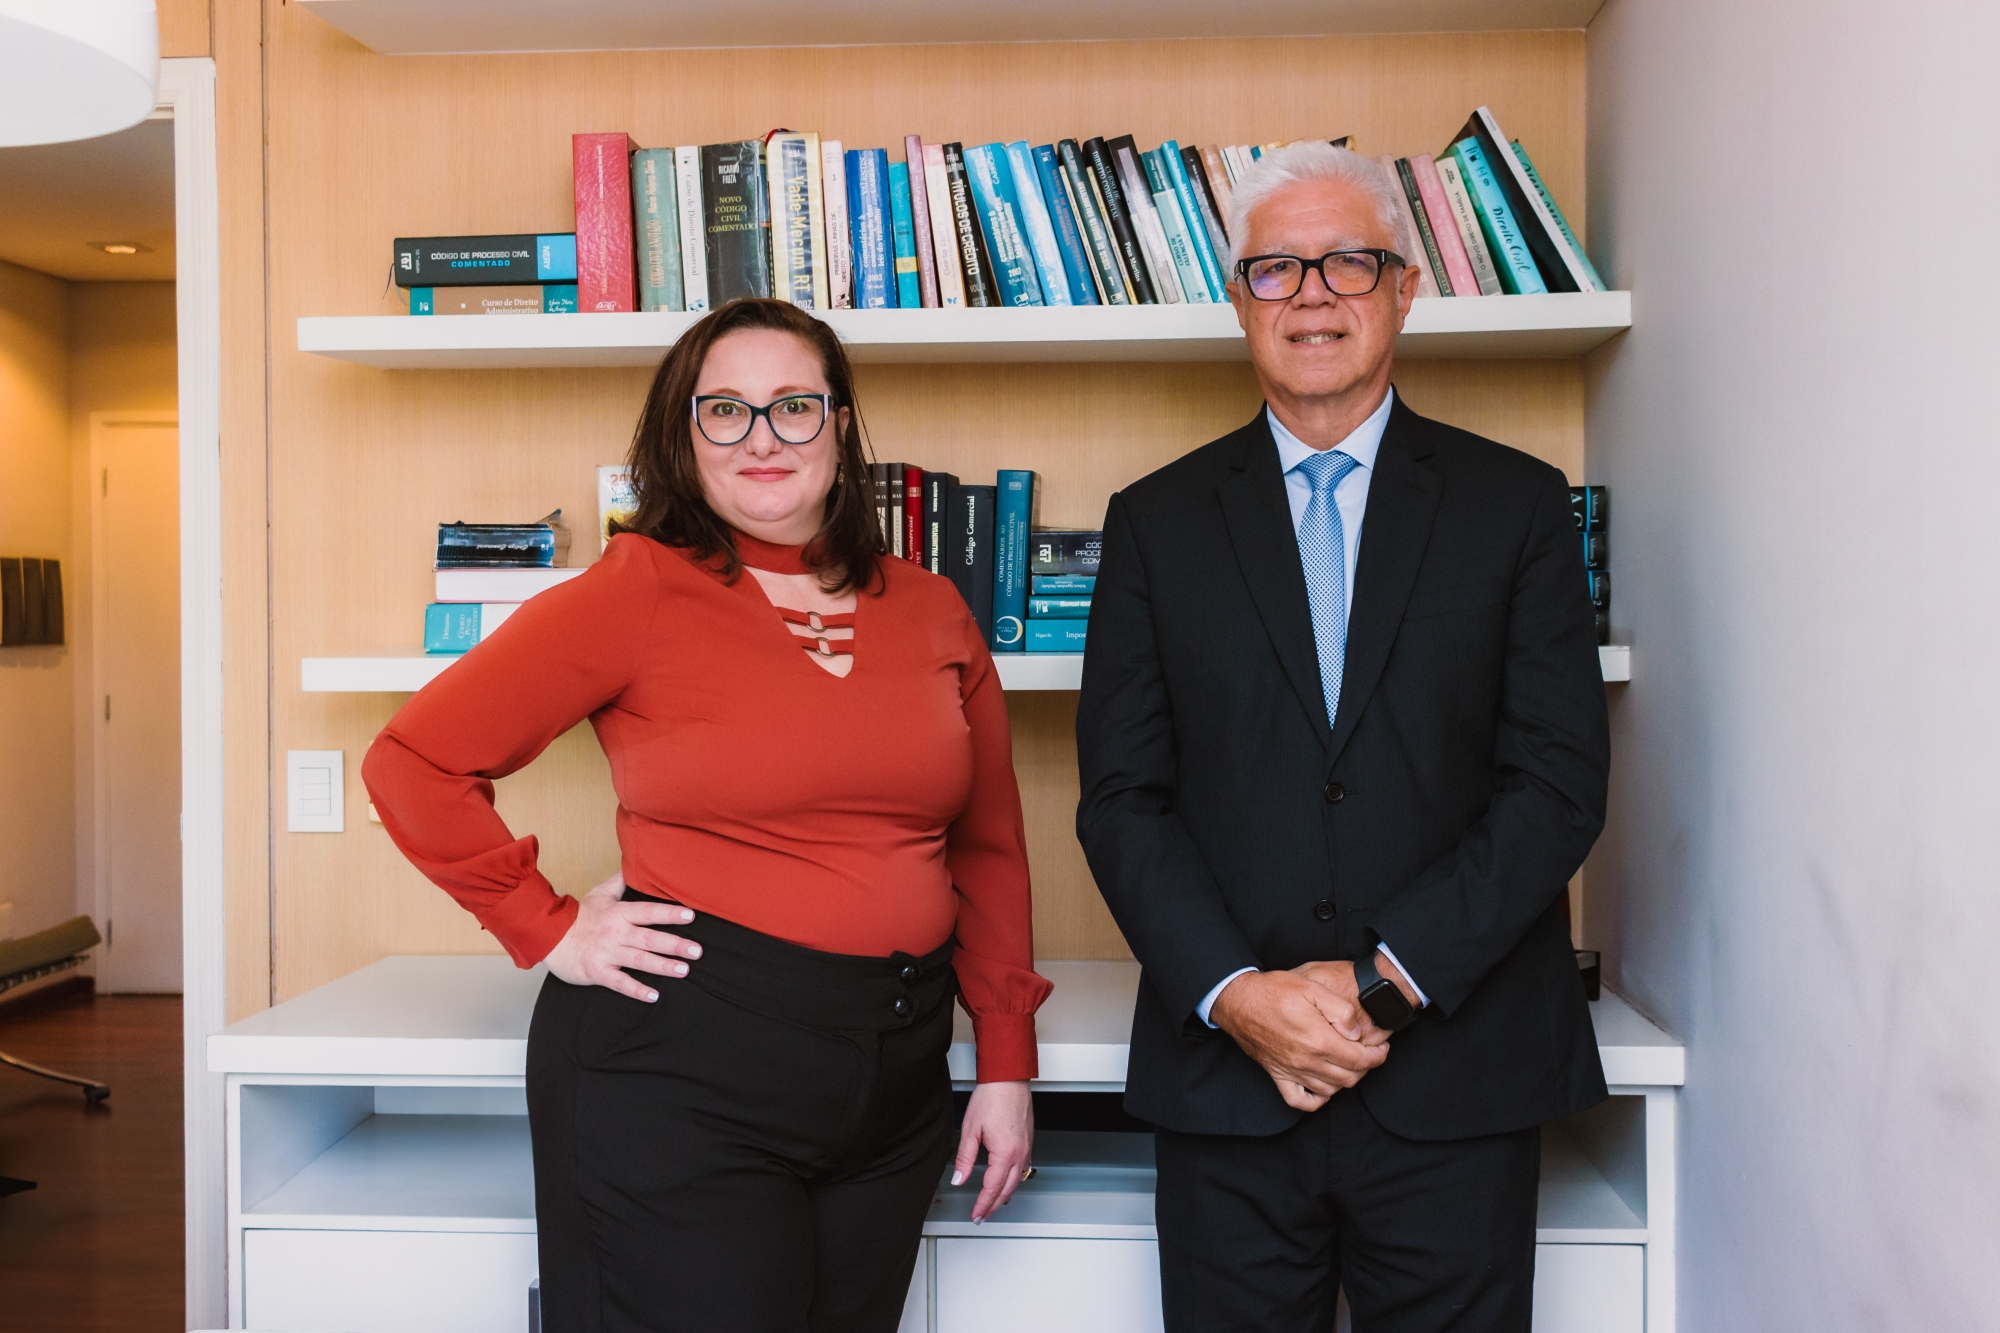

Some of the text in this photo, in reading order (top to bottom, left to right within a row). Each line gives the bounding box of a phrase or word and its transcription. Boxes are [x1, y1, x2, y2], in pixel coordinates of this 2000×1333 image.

[946, 153, 959, 162] FRAN
[646, 175, 656, 195] Helena
[685, 175, 694, 196] Curso
[859, 157, 869, 195] VALENTIN
[868, 158, 877, 194] CARRION
[1092, 151, 1120, 220] DIREITO COMERCIAL
[1104, 165, 1121, 201] CURSO DE
[647, 196, 657, 213] Maria
[687, 198, 695, 208] de
[719, 196, 742, 204] NOVO
[787, 176, 806, 212] Vade
[951, 178, 972, 219] TÍTULOS
[994, 196, 1003, 211] das
[1076, 181, 1095, 218] FALIMENTAR
[1180, 182, 1195, 211] MANUAL
[1452, 190, 1467, 214] FAMÍLIA
[715, 204, 747, 213] CÓDIGO
[830, 212, 836, 220] DE
[1052, 168, 1085, 273] MANUAL DE DIREITO COMERCIAL
[1055, 205, 1063, 215] DE
[1190, 211, 1198, 221] DE
[1415, 203, 1427, 224] CAUSA
[1462, 214, 1470, 223] DE
[688, 210, 697, 236] Direito
[708, 223, 758, 233] COMENTADO
[959, 219, 973, 234] DE
[1003, 202, 1024, 258] leis do trabalho
[1058, 215, 1071, 246] EMPRESA
[1088, 217, 1102, 241] DIREITO
[1193, 221, 1208, 249] DIREITO
[1465, 222, 1478, 245] DIREITO
[790, 216, 809, 269] Mecum
[838, 220, 846, 259] PROCESSUAL
[859, 222, 869, 268] comentários
[864, 205, 878, 267] consolidação das
[873, 209, 885, 267] leis do trabalho
[938, 230, 946, 247] Civil
[990, 217, 1008, 263] comentários
[996, 210, 1016, 261] consolidação
[1096, 241, 1105, 250] DE
[1426, 234, 1438, 254] VALOR
[1491, 205, 1532, 275] Direito Civil
[431, 252, 458, 260] CÓDIGO
[460, 252, 470, 260] DE
[542, 246, 551, 270] NERY
[647, 219, 665, 288] CÓDIGO CIVIL ANOTADO
[690, 237, 700, 276] Comercial
[941, 249, 950, 276] Direito
[961, 233, 983, 276] CRÉDITO
[1035, 246, 1046, 267] Curso
[1099, 250, 1112, 271] CURSO
[1124, 241, 1142, 282] Fran Martins
[1170, 236, 1185, 267] CURSO DE
[1473, 244, 1485, 264] NOVO
[451, 260, 510, 268] COMENTADO
[1202, 249, 1221, 287] COMERCIAL
[794, 274, 811, 292] RT
[1046, 274, 1057, 289] 2
[1437, 264, 1451, 291] MANUAL
[482, 299, 502, 307] Curso
[966, 495, 976, 565] Código Comercial
[1001, 525, 1006, 534] AO
[1007, 561, 1013, 570] DE
[1005, 571, 1013, 596] CÓDIGO
